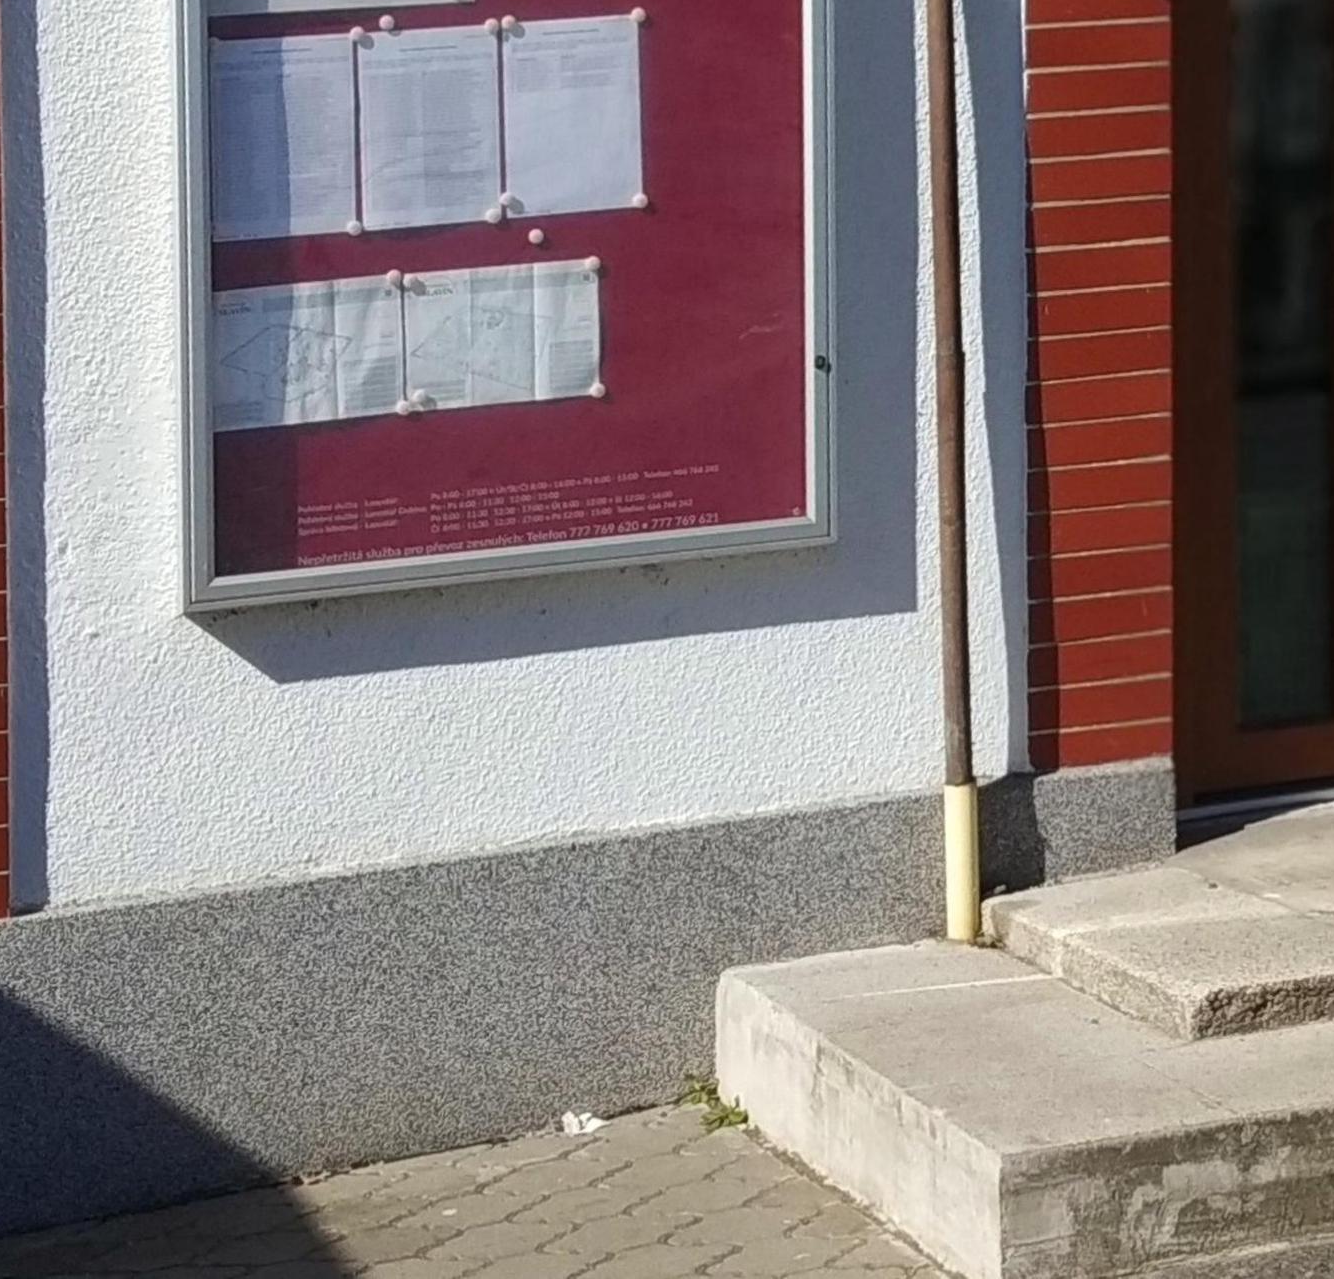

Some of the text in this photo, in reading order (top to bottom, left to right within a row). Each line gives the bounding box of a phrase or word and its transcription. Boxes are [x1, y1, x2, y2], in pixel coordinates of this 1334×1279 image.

[365, 546, 402, 559] služba
[404, 544, 424, 556] pro
[526, 529, 567, 542] Telefon
[651, 516, 673, 530] 777
[674, 514, 696, 527] 769
[697, 511, 720, 525] 621
